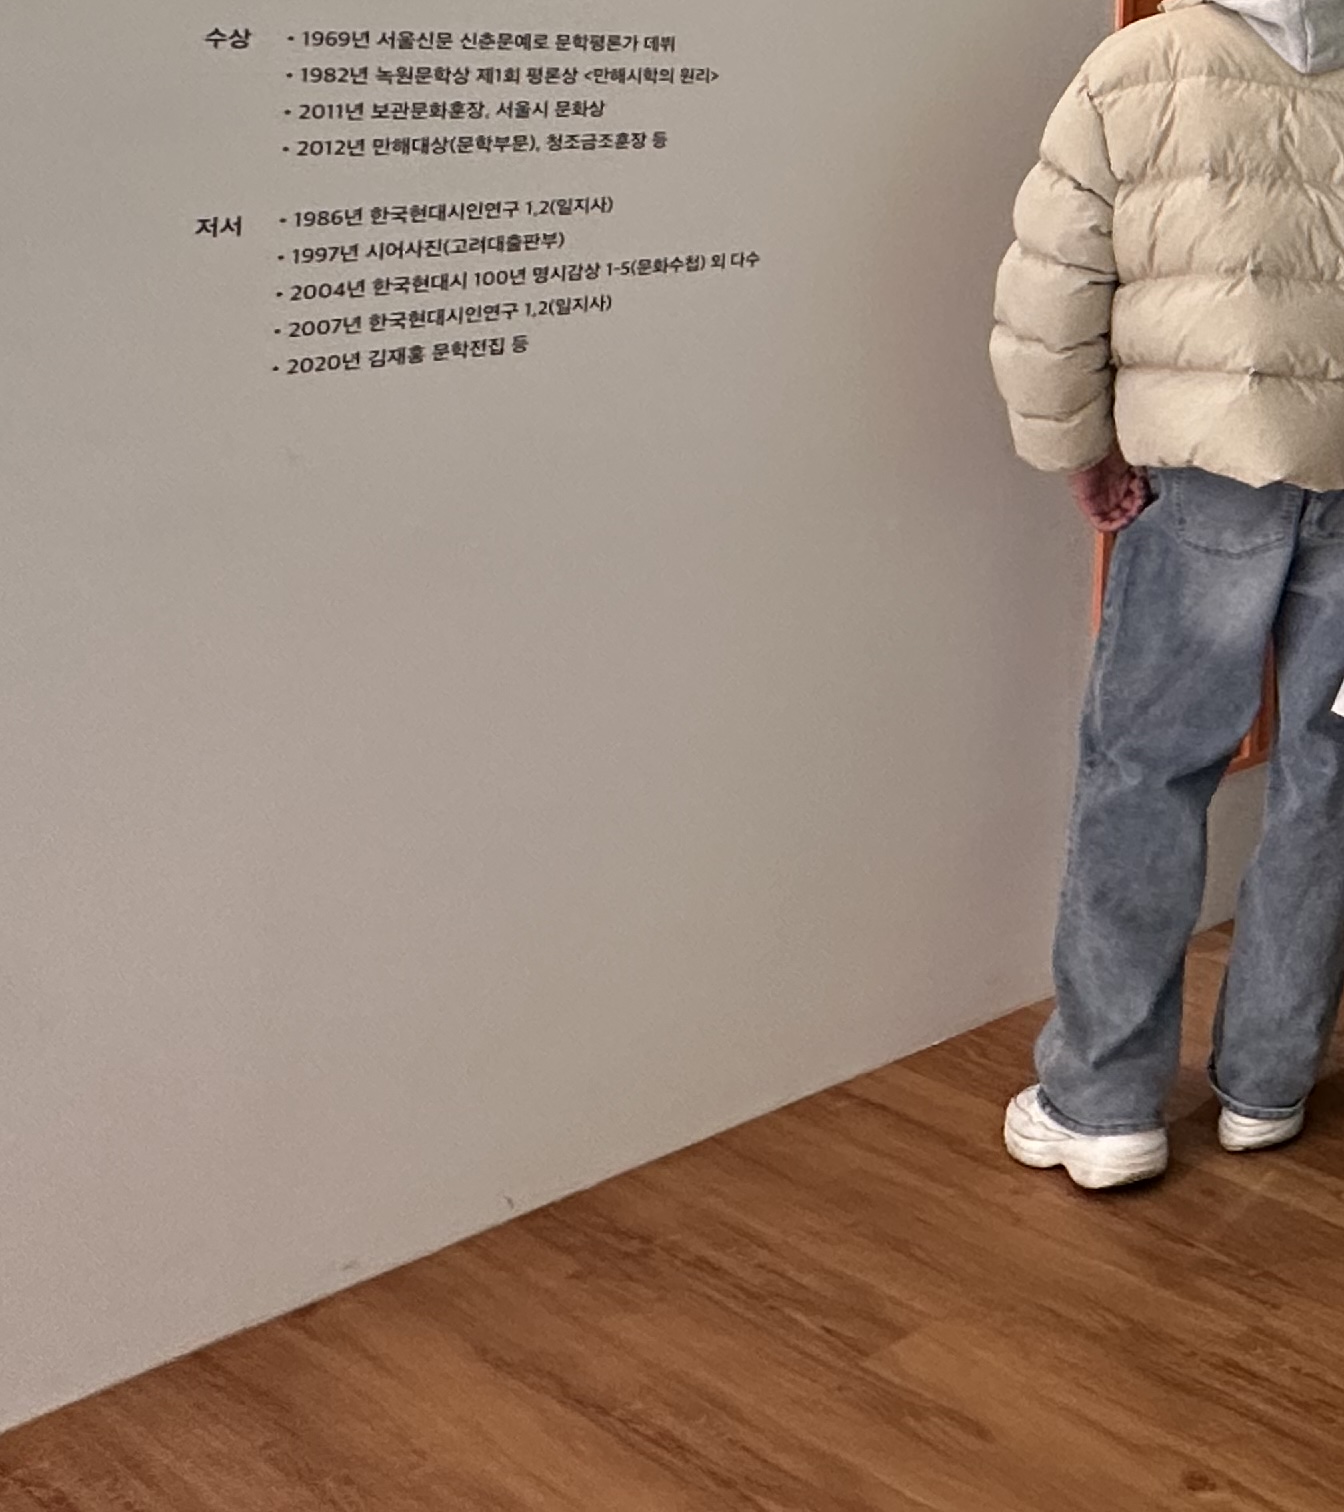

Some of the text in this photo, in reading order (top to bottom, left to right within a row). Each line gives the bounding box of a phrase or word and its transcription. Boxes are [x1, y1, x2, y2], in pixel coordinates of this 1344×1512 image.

[205, 28, 251, 49] 수상
[303, 31, 675, 52] 1969년 서울신문 신춘문예로 문학평론가 데뷔
[302, 66, 719, 85] 1982년 녹원문학상 제1회 평론상 <만해시학의 원리>
[299, 102, 363, 121] 2011년
[496, 101, 548, 119] 서울시
[555, 100, 605, 117] 문화상
[297, 139, 365, 156] 2012년
[652, 131, 667, 149] 등
[195, 216, 241, 237] 저서
[295, 207, 362, 227] 1986년
[371, 201, 519, 225] 한국현대시인연구
[293, 232, 565, 264] 1997년 시어사진(고려대출판부)
[290, 251, 760, 301] 2004년 한국현대시 100년 명시감상 1-5(문화수첩) 외 다수
[289, 316, 361, 337] 2007년
[369, 303, 519, 332] 한국현대시인연구
[287, 335, 529, 374] 2020년 김재홍 문학전집 등
